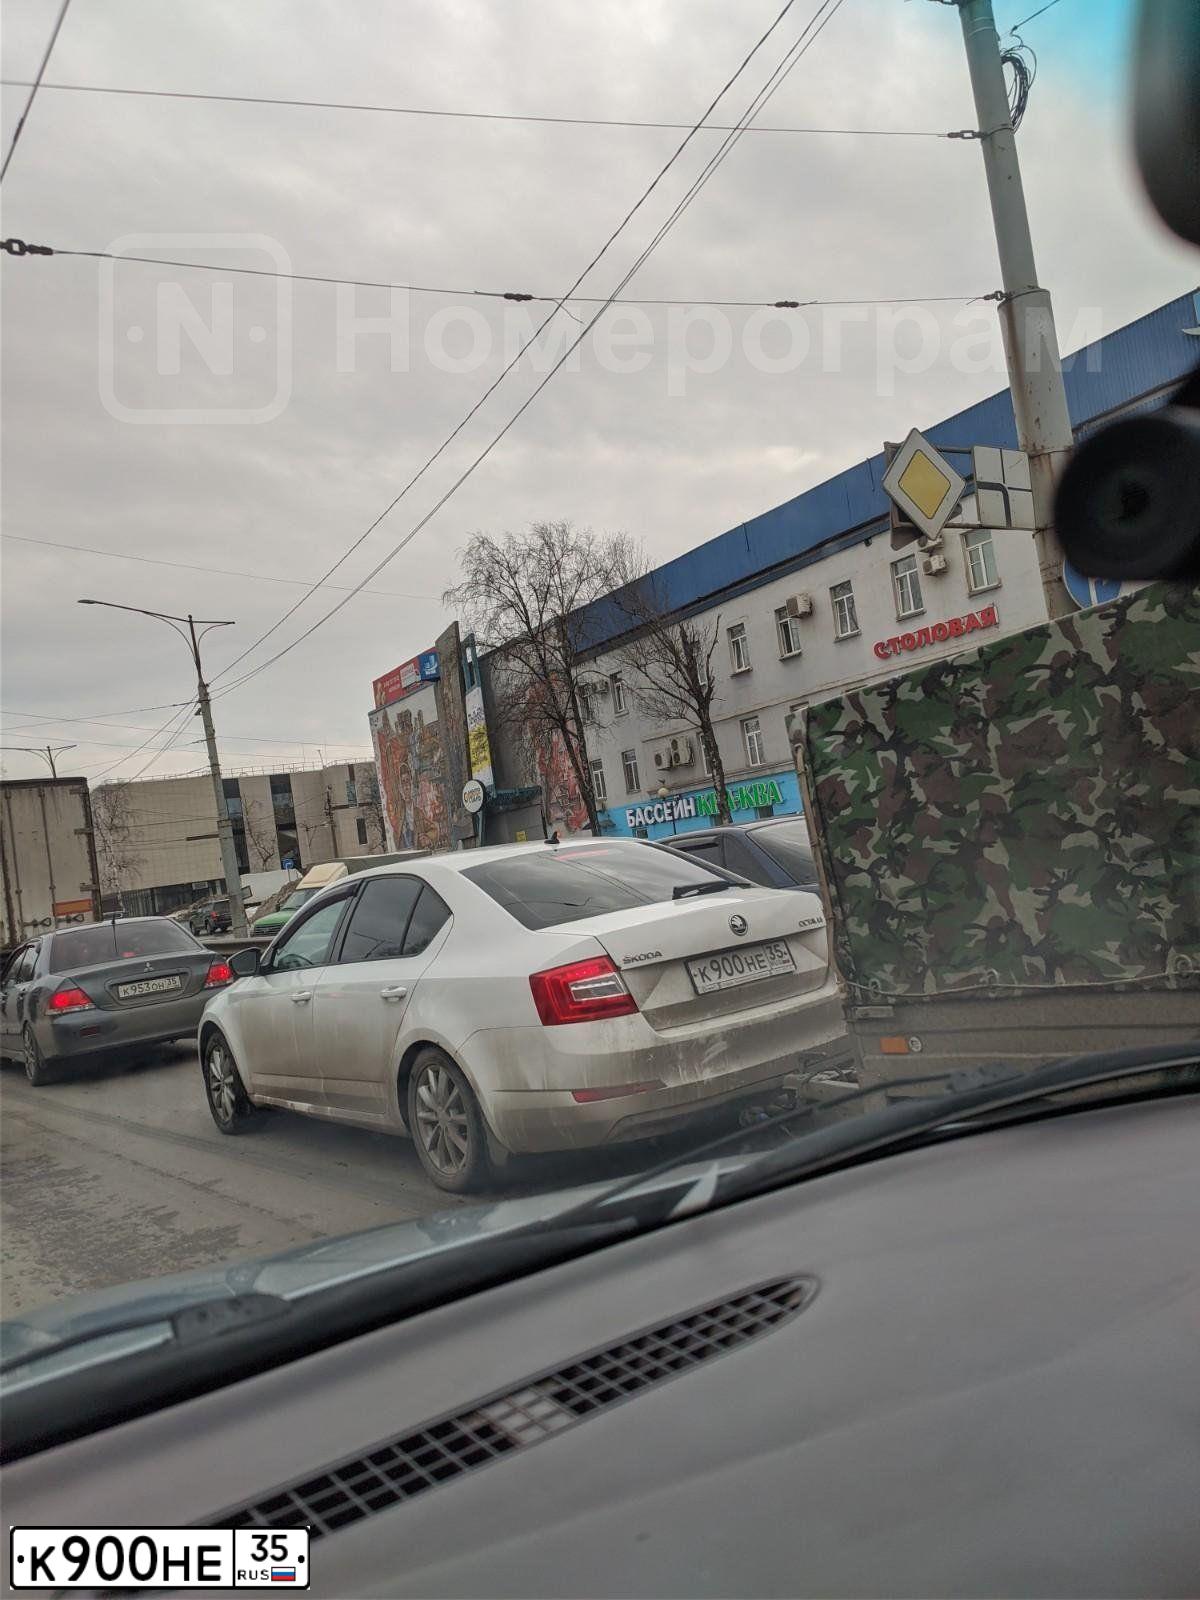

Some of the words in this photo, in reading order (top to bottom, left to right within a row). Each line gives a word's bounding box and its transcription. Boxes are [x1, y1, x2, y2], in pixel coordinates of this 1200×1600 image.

[873, 605, 999, 660] СТОЛОВАЯ
[626, 794, 697, 828] БАССЕЙН
[697, 953, 767, 983] К900НЕ
[765, 944, 784, 960] 35
